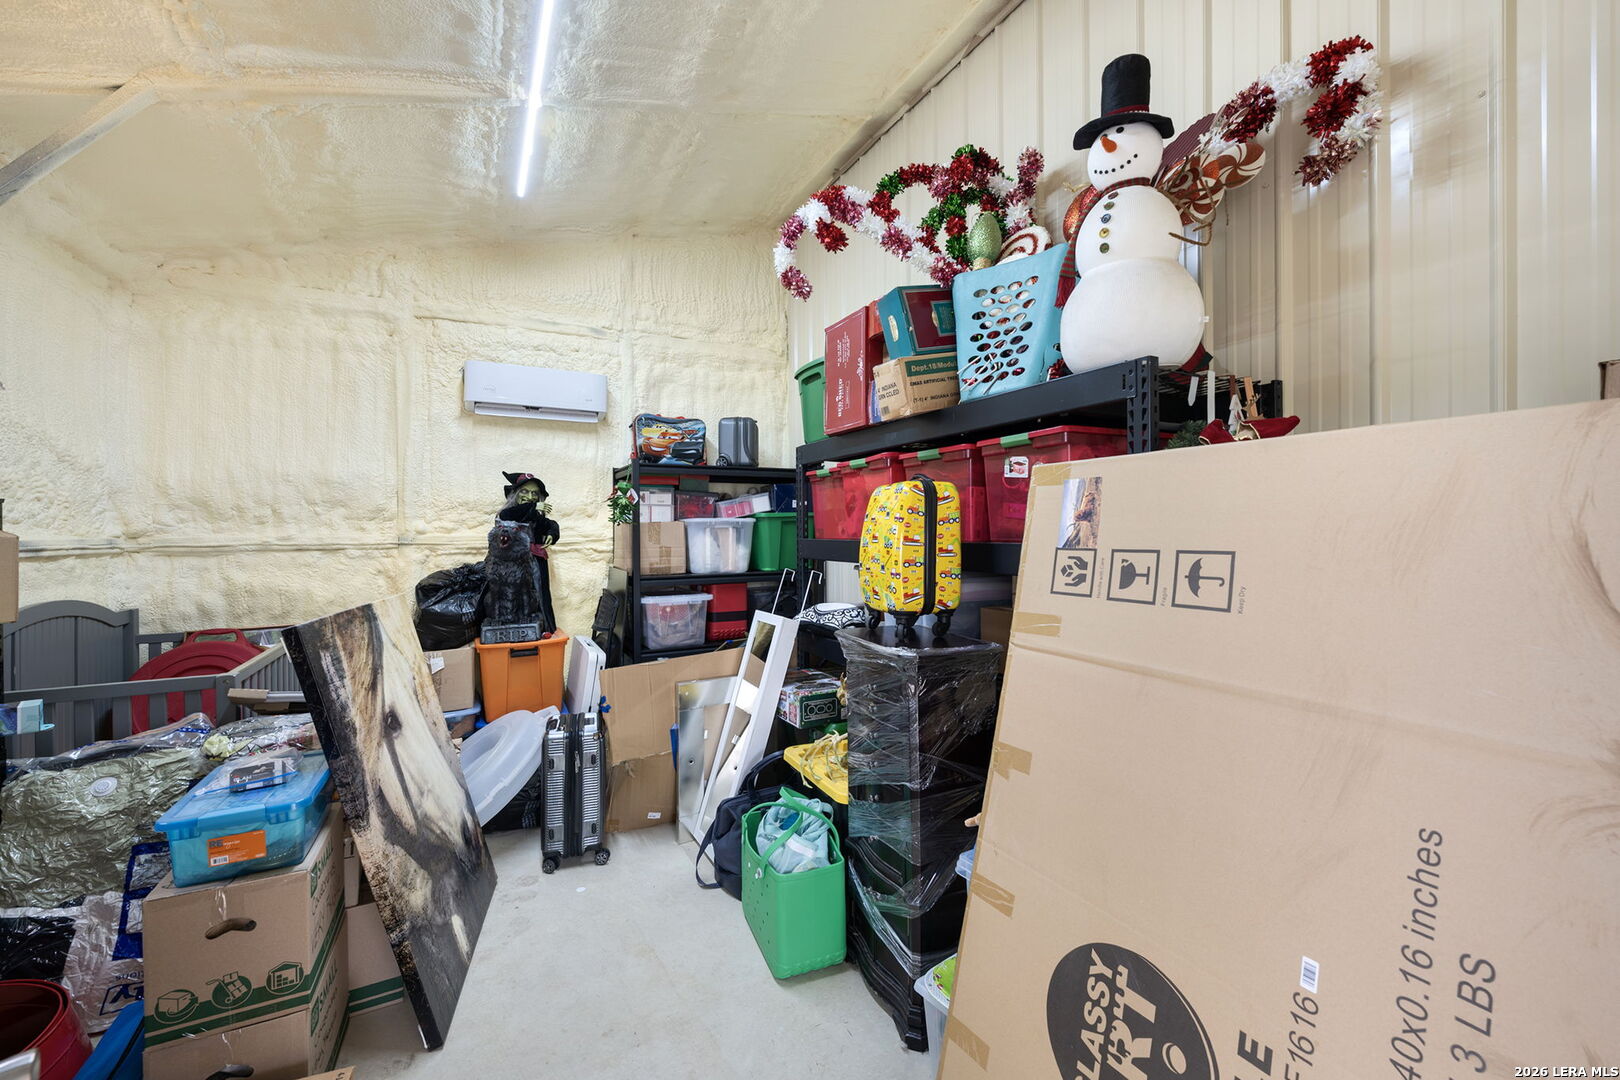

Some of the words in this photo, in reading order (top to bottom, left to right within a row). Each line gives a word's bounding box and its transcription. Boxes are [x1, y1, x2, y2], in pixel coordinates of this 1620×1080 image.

[497, 630, 528, 641] RIP
[1402, 828, 1443, 941] inches
[1075, 948, 1113, 1080] LASSY
[1455, 953, 1496, 1038] LBS
